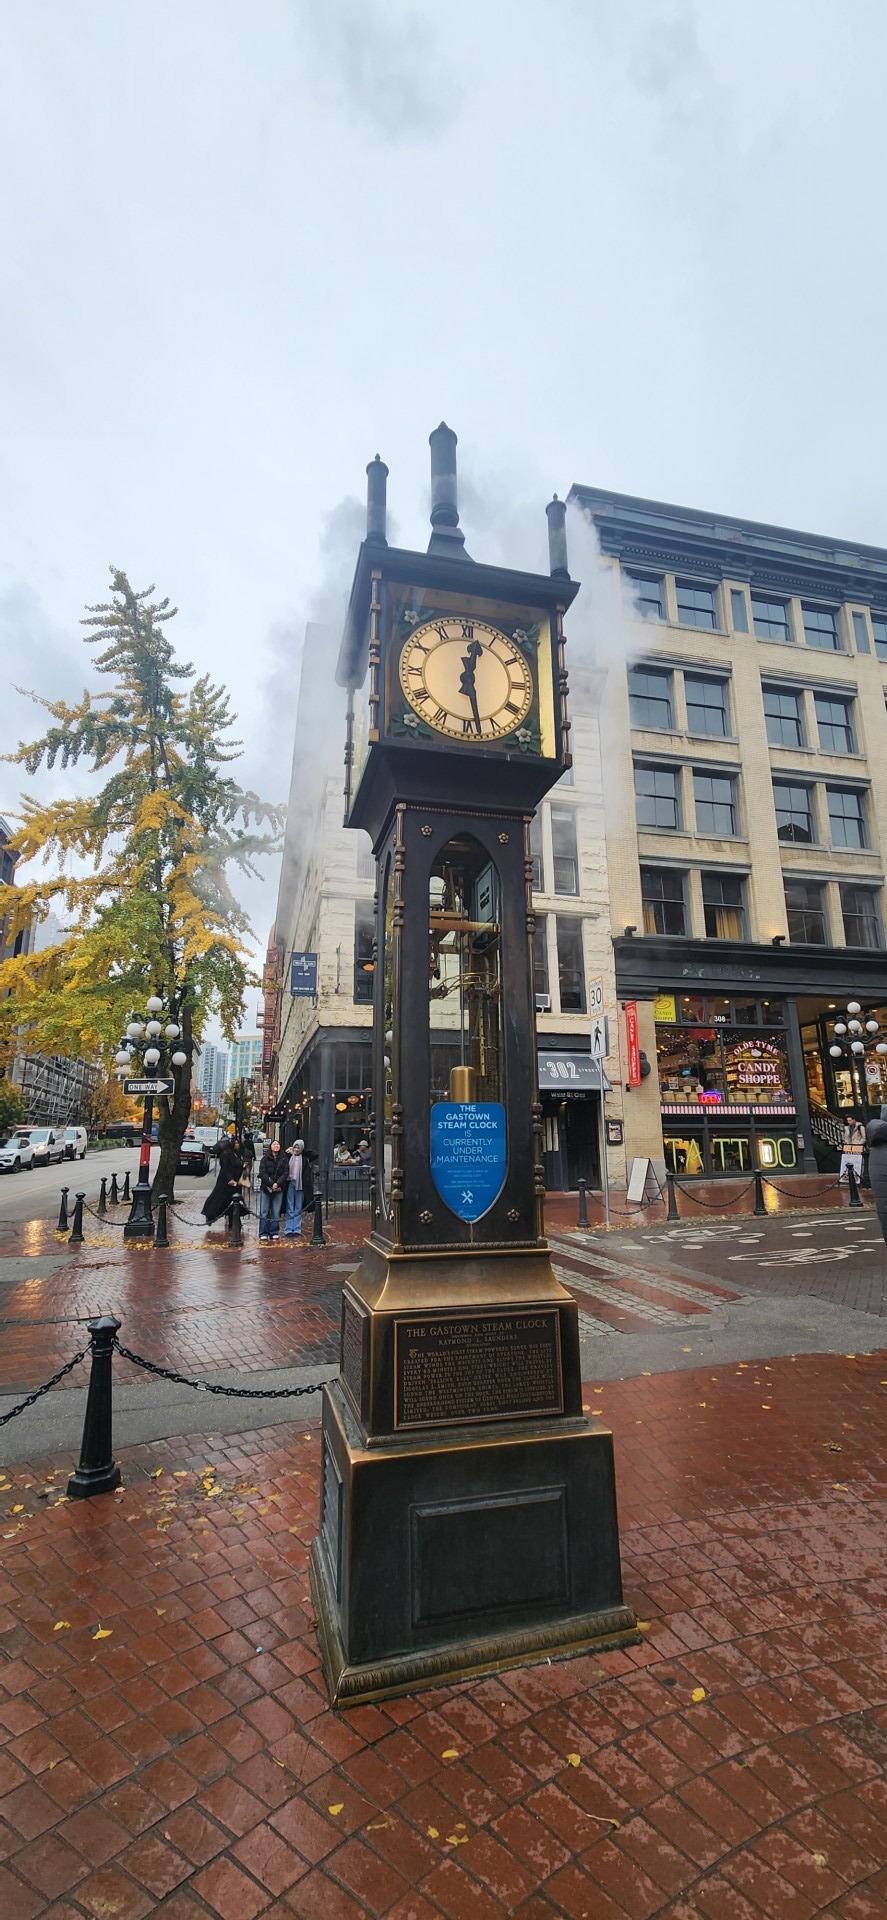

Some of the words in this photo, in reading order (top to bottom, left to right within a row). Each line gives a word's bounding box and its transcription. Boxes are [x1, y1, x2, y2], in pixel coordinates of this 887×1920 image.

[462, 625, 474, 639] XII
[590, 987, 602, 1006] 30
[734, 1040, 754, 1055] OLDE
[756, 1040, 778, 1056] TYME
[546, 1062, 580, 1078] 302
[738, 1062, 778, 1072] CANDY
[738, 1074, 781, 1084] SHOPPE
[452, 1146, 483, 1154] UNDER
[665, 1138, 796, 1174] TATTOO
[436, 1155, 498, 1163] MAINTENANCE
[407, 1328, 426, 1338] THE
[430, 1324, 478, 1336] GASTOWN
[482, 1322, 512, 1332] STEAM
[516, 1319, 548, 1330] CLOCK
